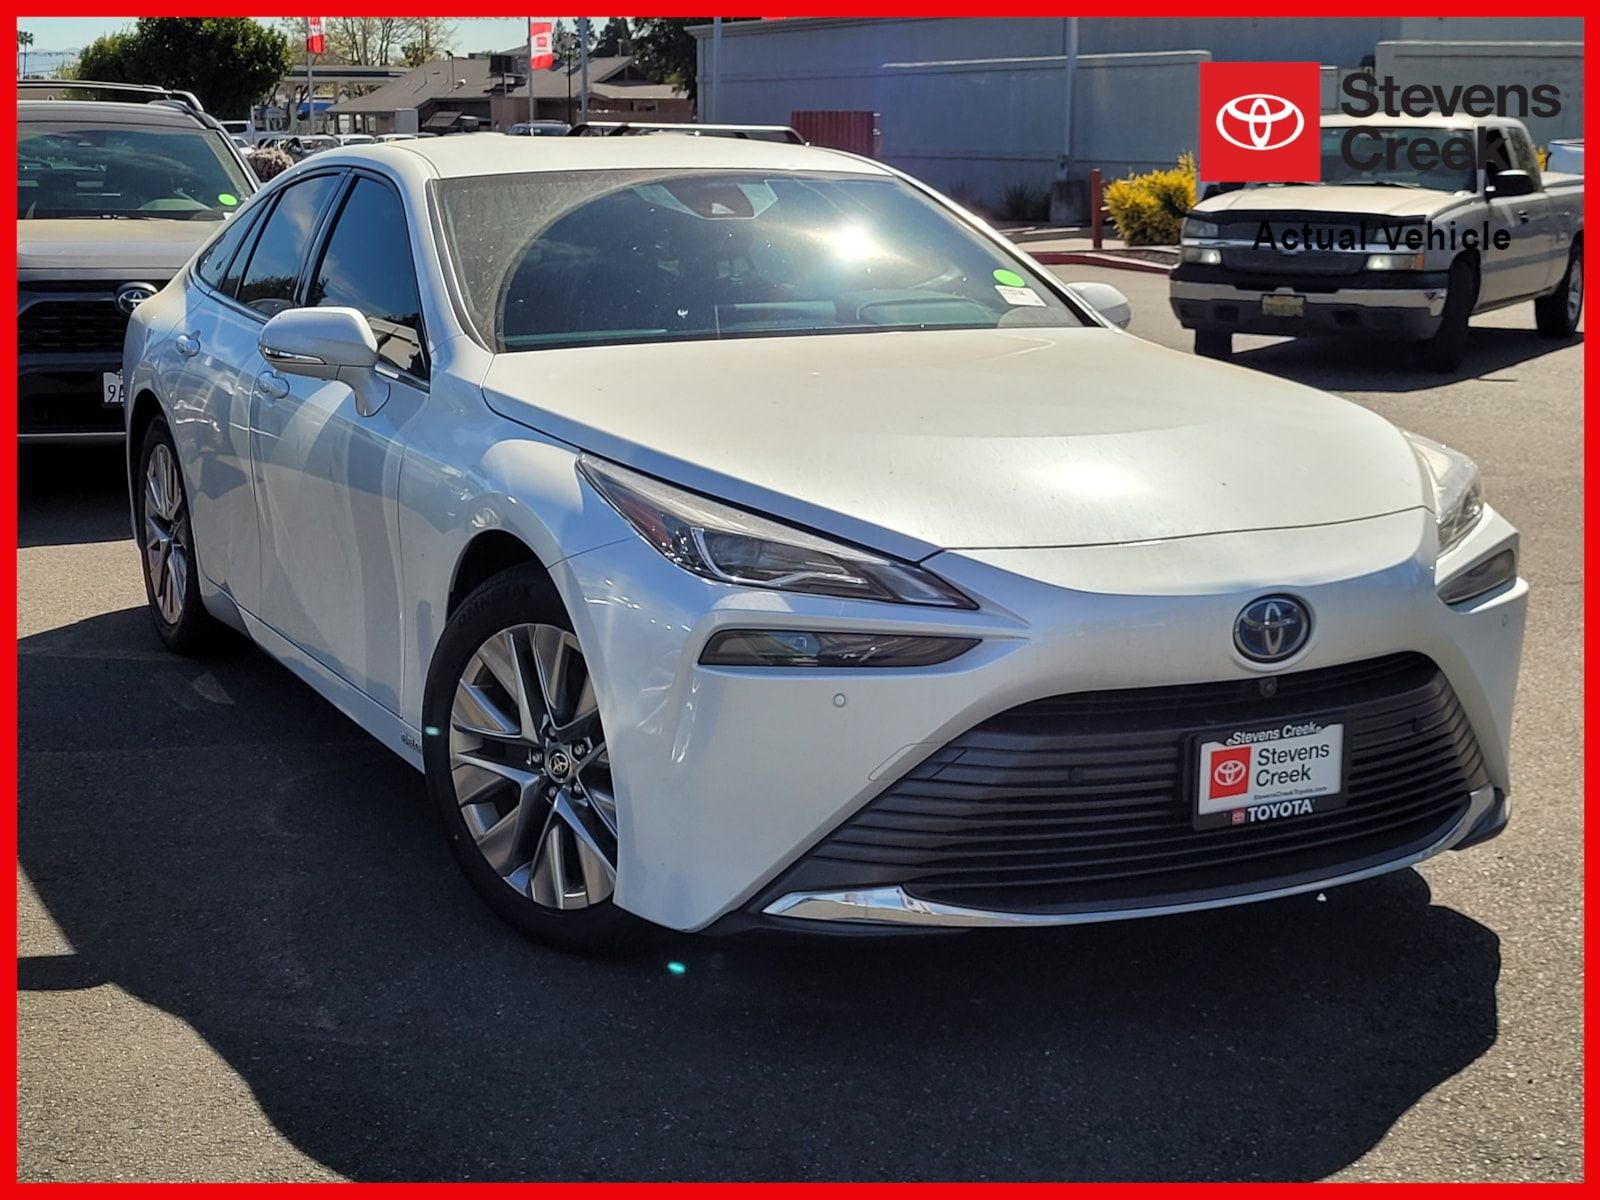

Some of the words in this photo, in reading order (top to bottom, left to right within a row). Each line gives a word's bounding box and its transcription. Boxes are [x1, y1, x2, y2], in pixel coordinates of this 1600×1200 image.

[1232, 728, 1280, 745] Stevens
[1282, 722, 1316, 739] Creek
[1257, 743, 1330, 766] Stevens
[1256, 764, 1312, 787] Creek
[1248, 799, 1313, 822] TOYOTA
